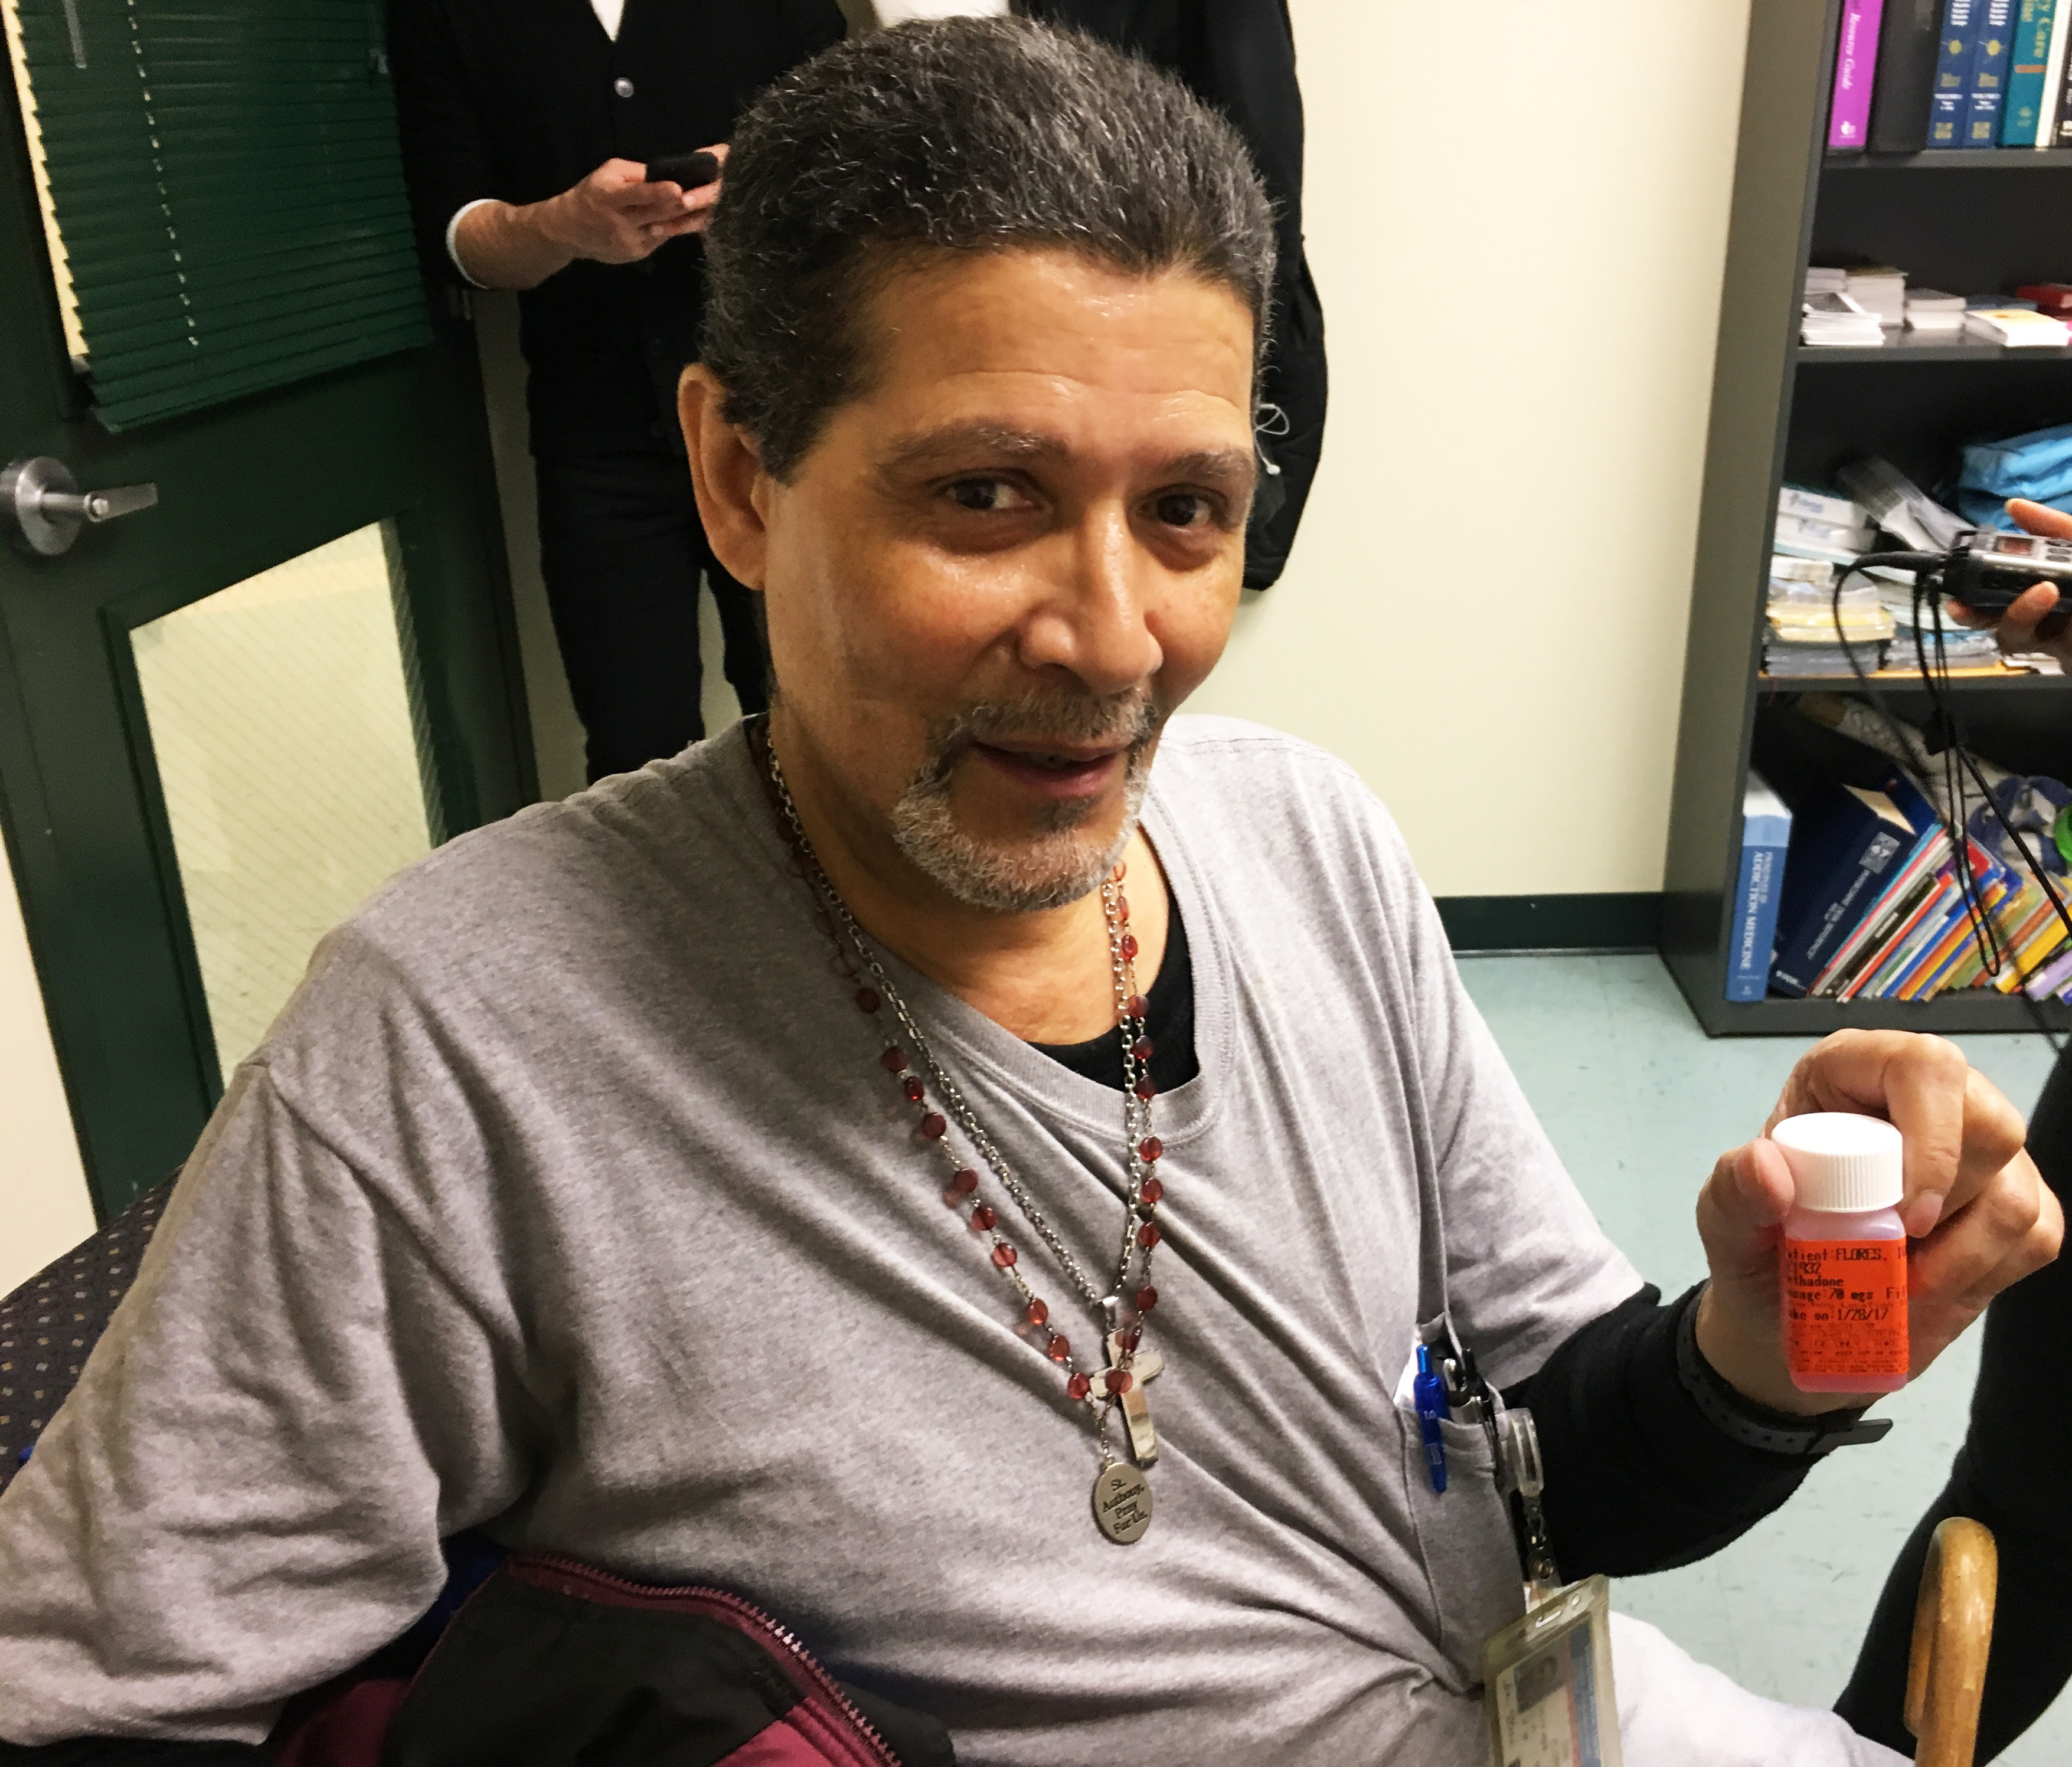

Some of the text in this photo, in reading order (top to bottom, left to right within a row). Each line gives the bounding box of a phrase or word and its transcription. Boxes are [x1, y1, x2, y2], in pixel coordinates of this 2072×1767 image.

[1740, 916, 1756, 970] MEDICINE
[1115, 1501, 1139, 1520] Pray
[1113, 1519, 1132, 1535] For
